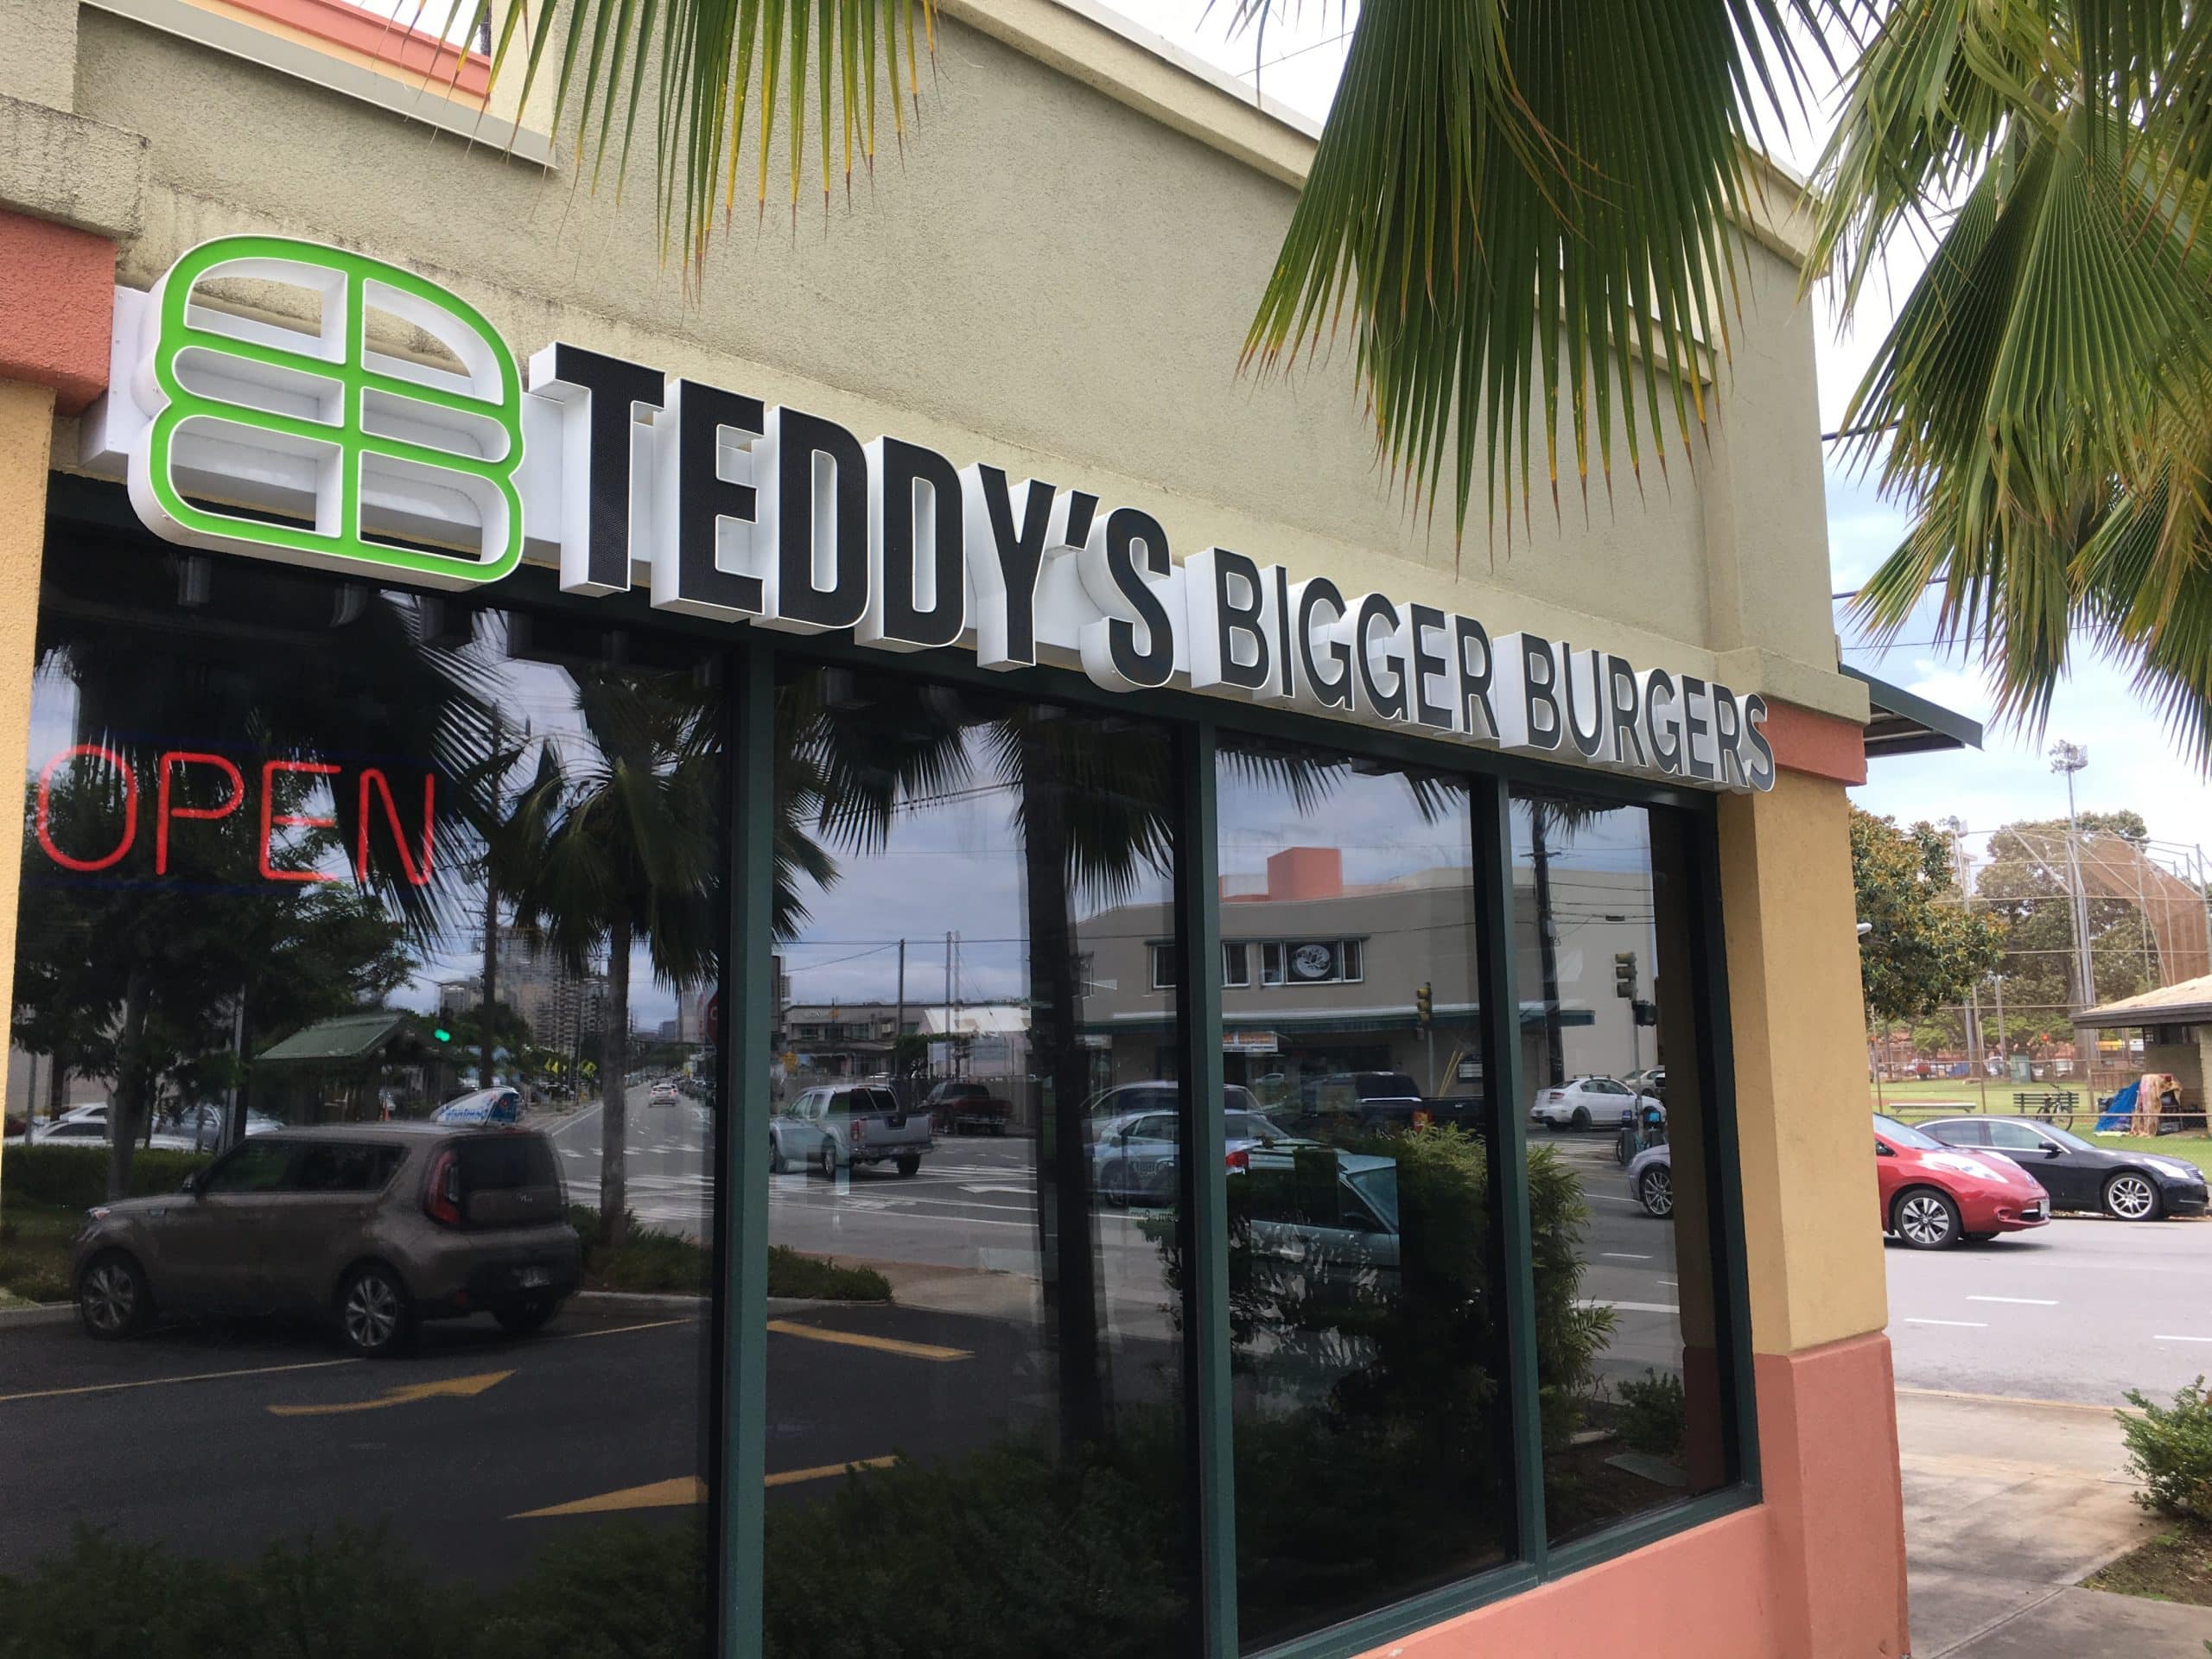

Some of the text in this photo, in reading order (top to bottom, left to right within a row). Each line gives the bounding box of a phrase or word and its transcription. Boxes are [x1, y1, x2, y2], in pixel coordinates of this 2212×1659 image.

[553, 340, 1776, 793] TEDDY'S BIGGER BURGERS
[35, 743, 435, 886] OPEN
